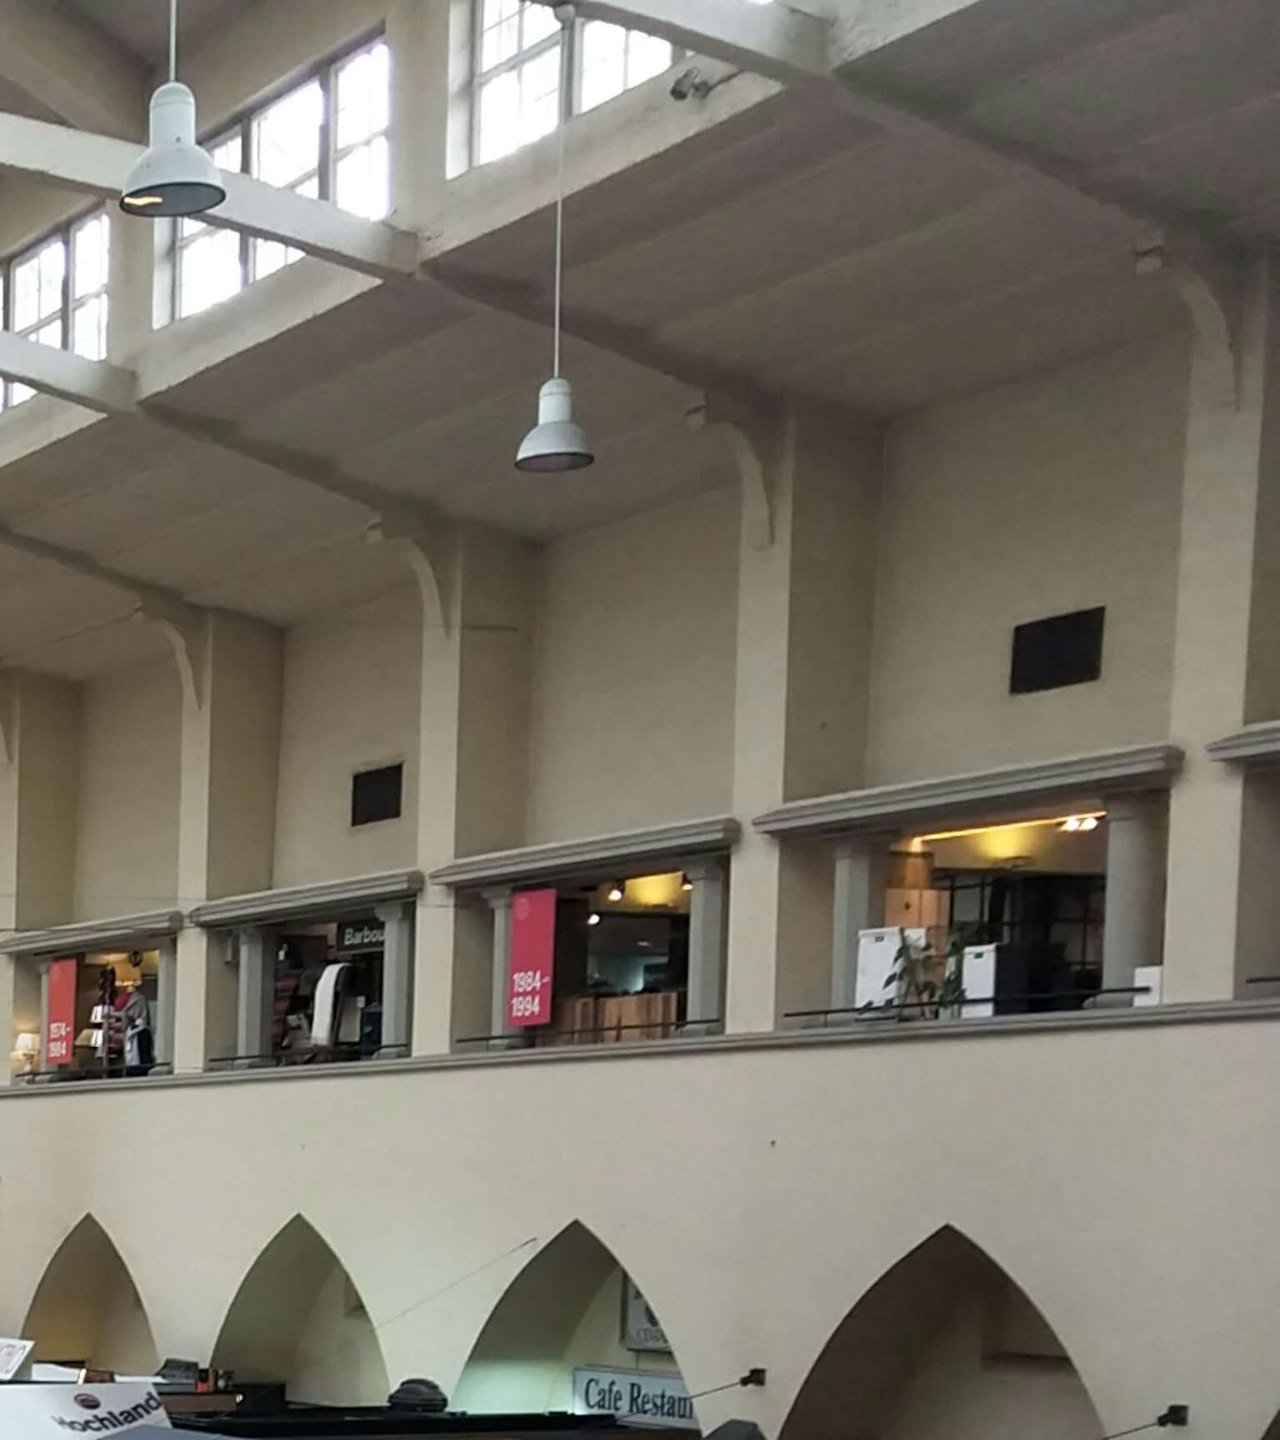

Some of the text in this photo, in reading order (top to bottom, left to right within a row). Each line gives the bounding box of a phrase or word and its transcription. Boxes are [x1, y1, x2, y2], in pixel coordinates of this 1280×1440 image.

[510, 996, 540, 1018] 1994
[51, 1391, 163, 1433] Hochland
[583, 1377, 623, 1412] Cafe
